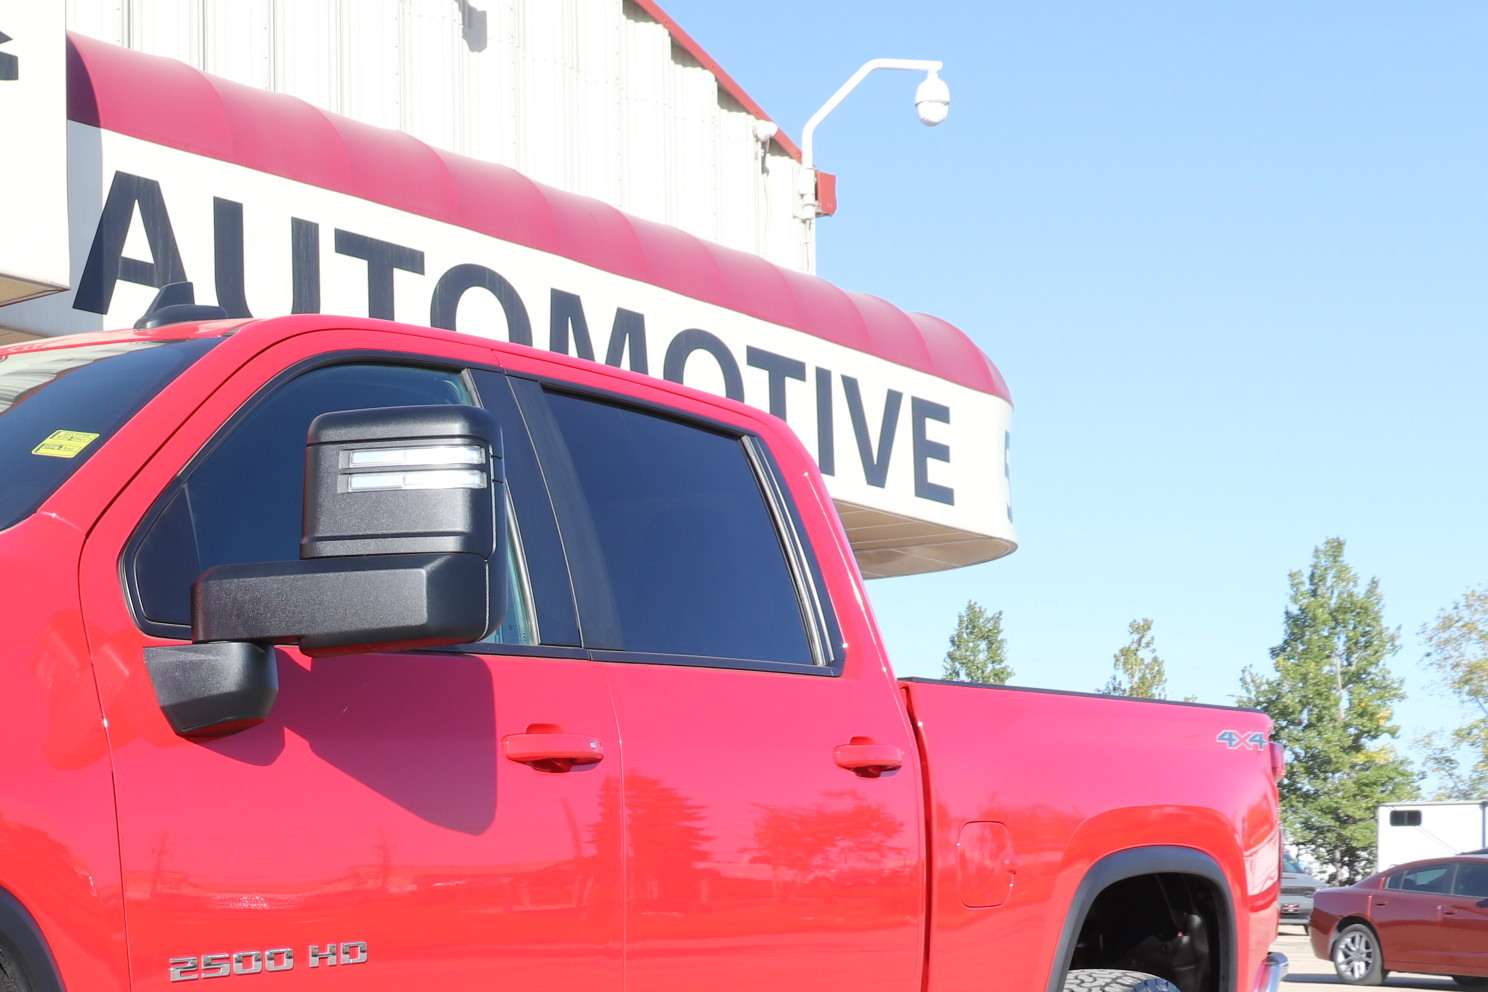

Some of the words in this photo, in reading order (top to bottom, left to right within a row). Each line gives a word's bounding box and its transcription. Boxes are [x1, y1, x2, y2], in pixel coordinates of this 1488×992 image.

[73, 171, 955, 506] AUTOMOTIVE
[169, 948, 294, 982] 2500
[309, 941, 368, 968] HD
